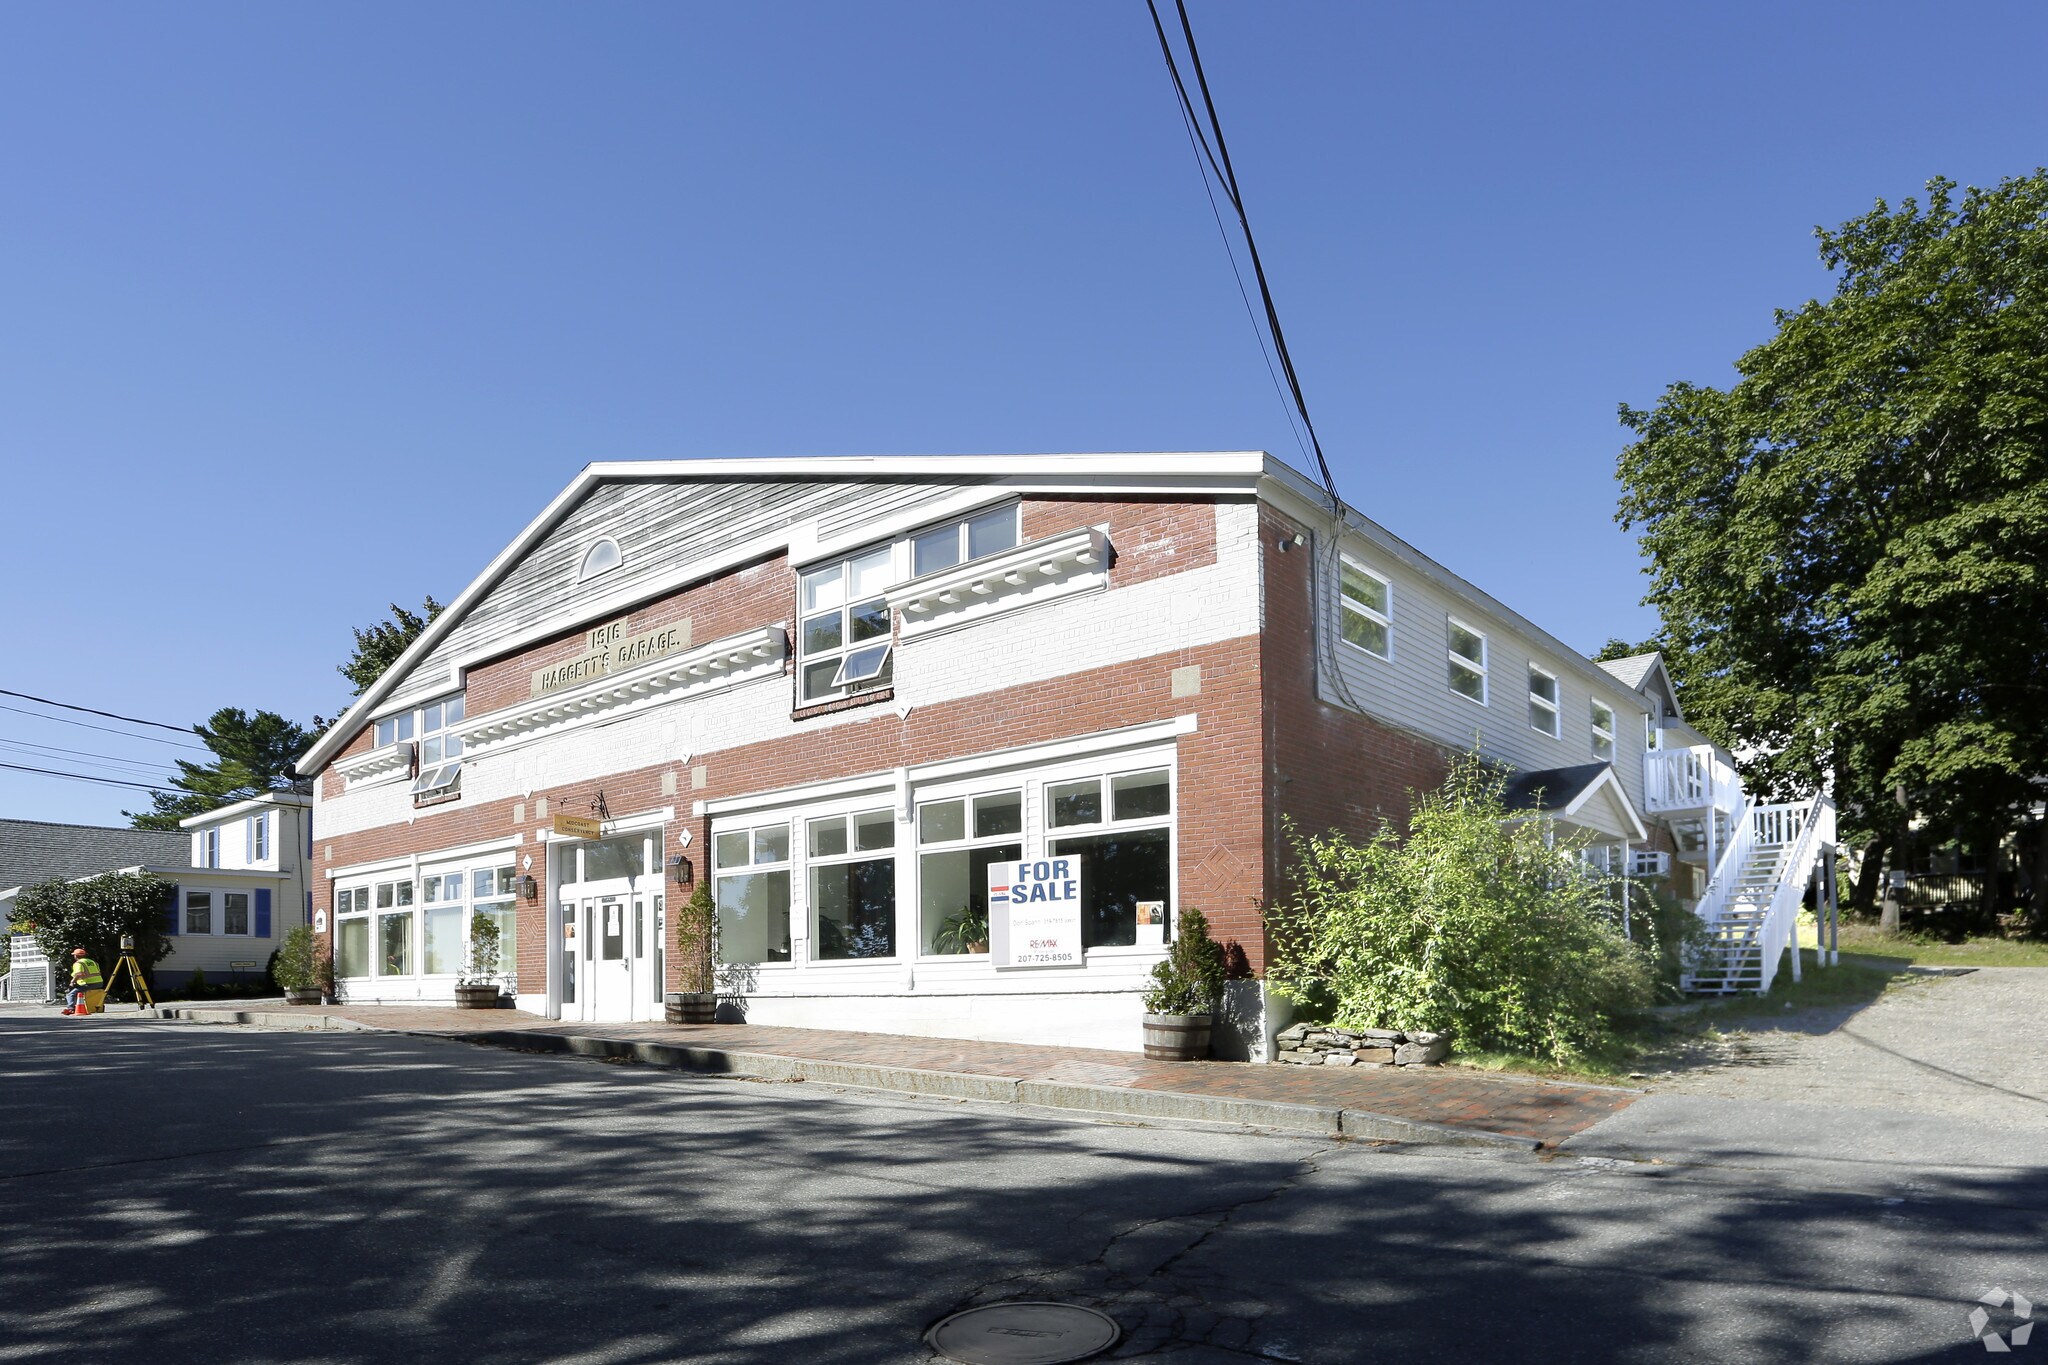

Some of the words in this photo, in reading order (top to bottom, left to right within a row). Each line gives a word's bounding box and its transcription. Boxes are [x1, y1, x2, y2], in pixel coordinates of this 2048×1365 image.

[1018, 860, 1069, 882] FOR
[1011, 880, 1077, 904] SALE
[1029, 939, 1058, 949] RE/MAX
[1017, 953, 1073, 963] 207-725-8505
